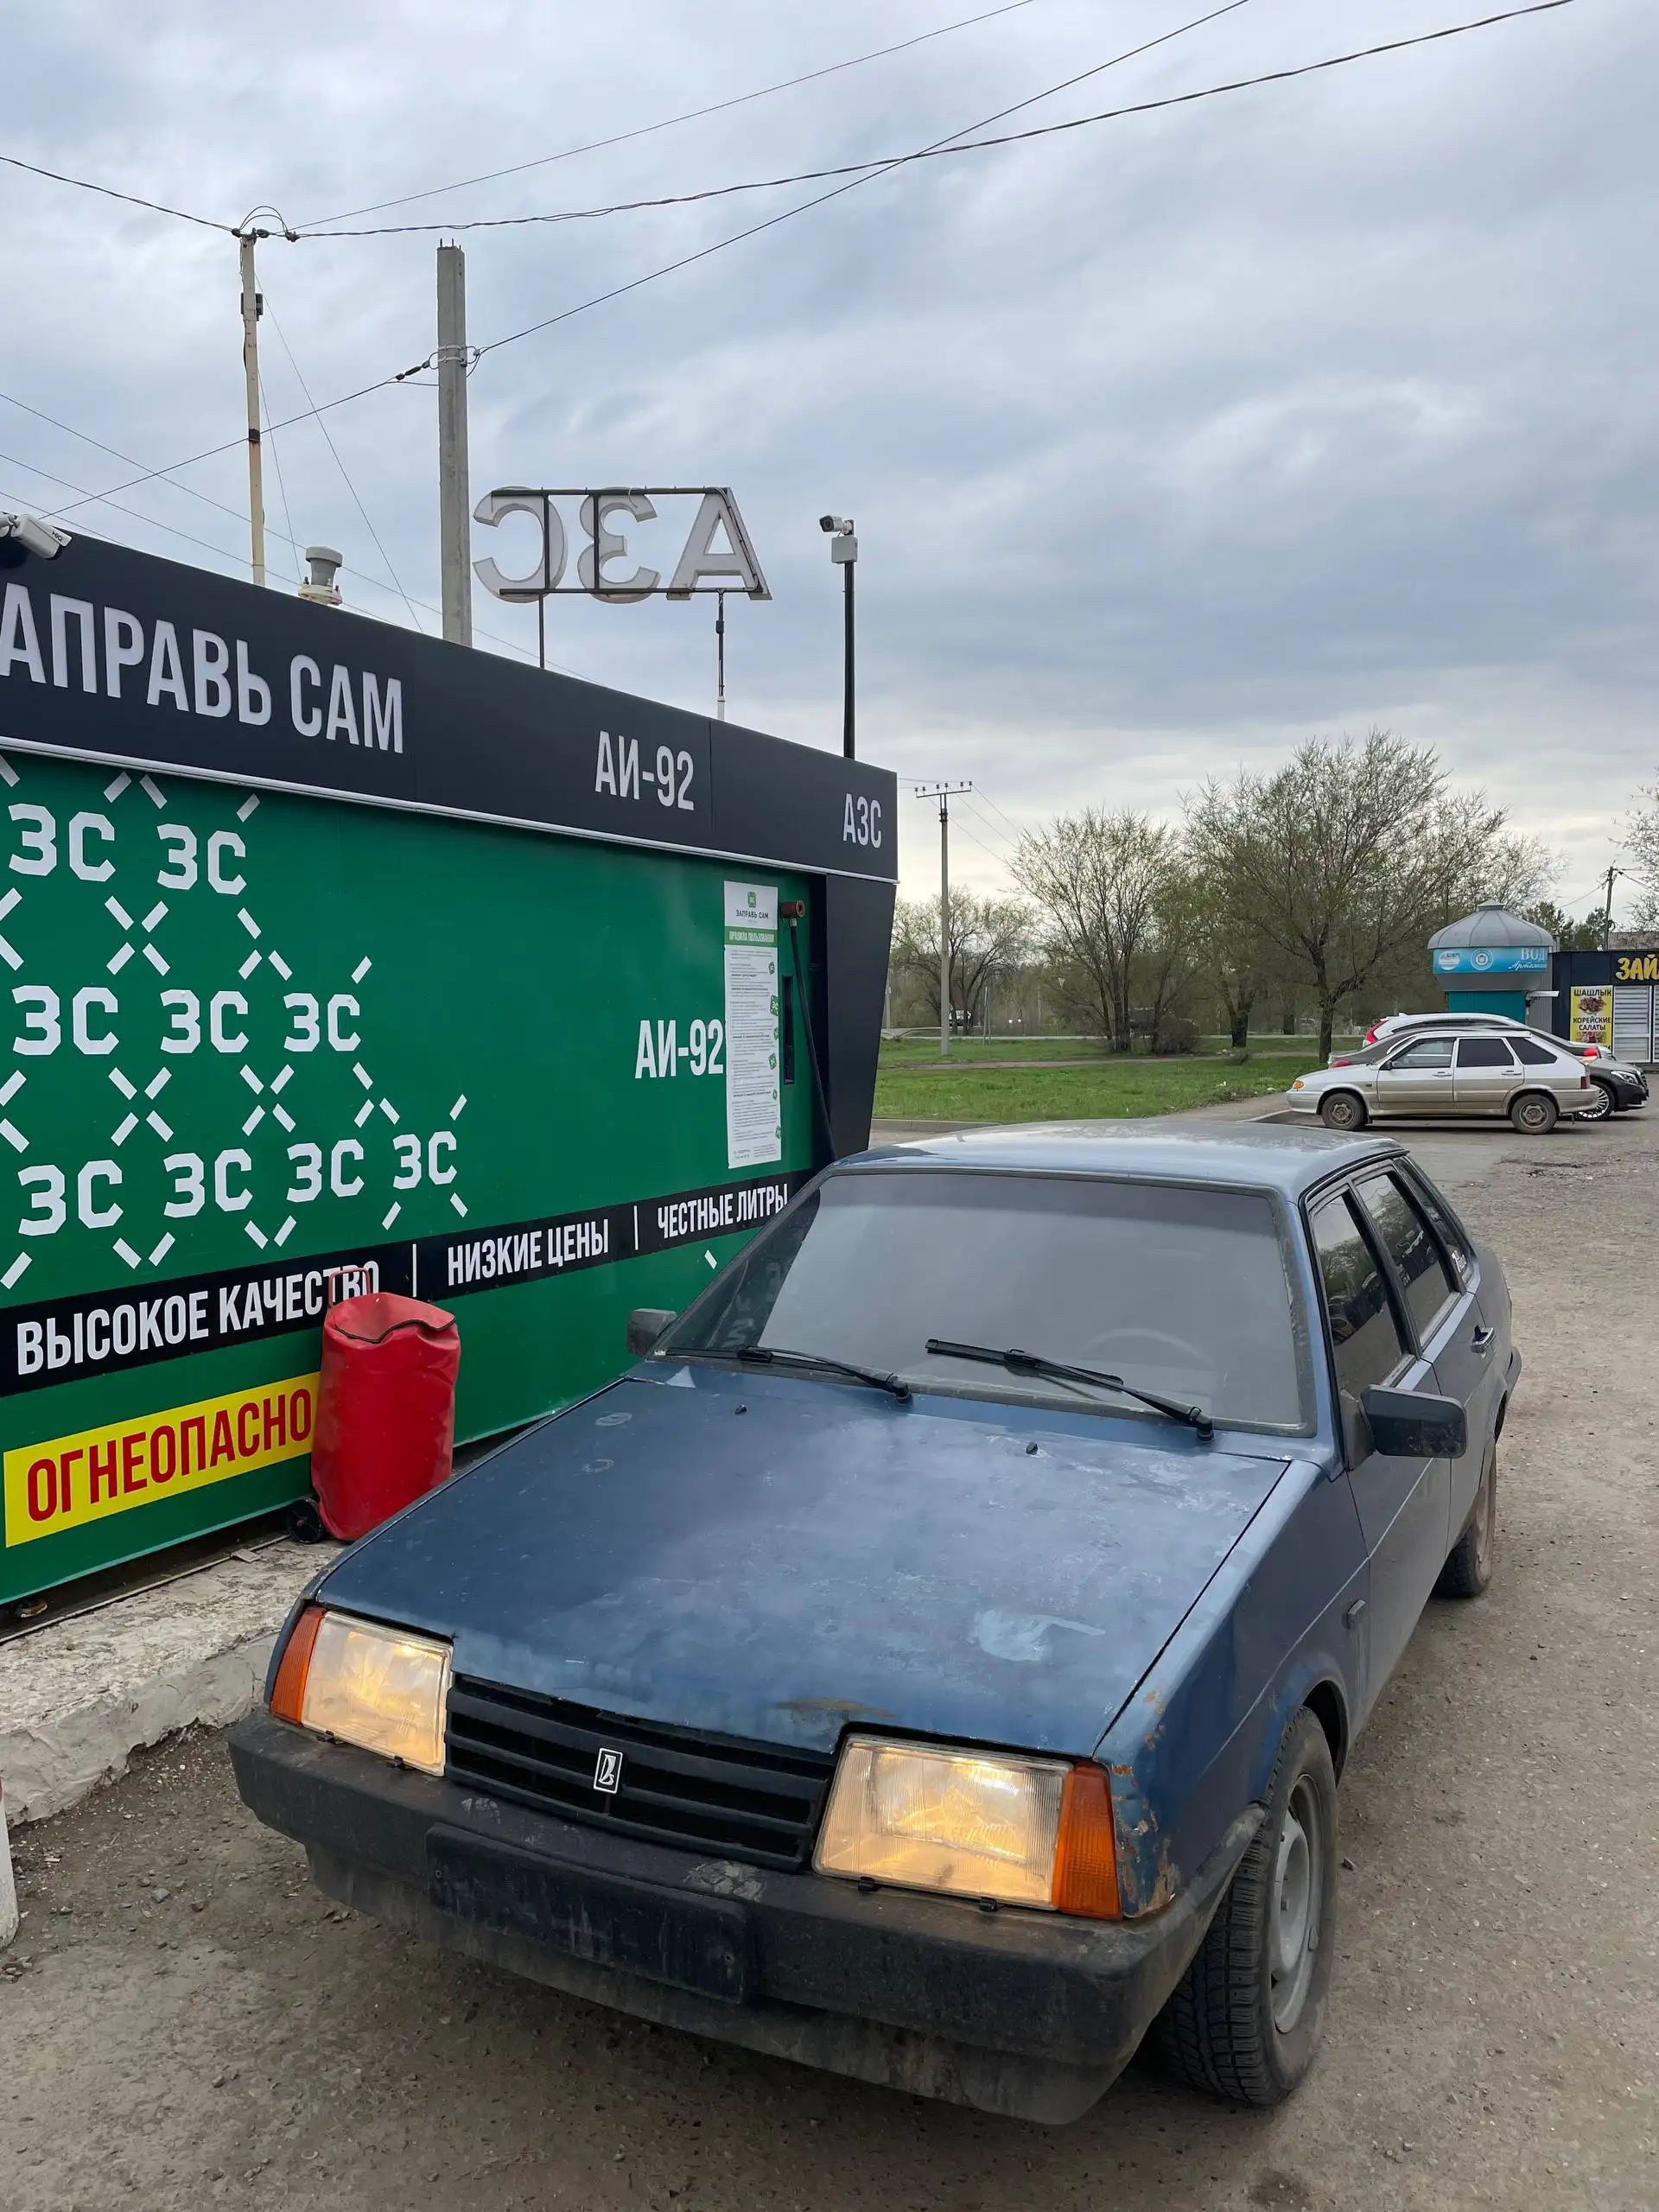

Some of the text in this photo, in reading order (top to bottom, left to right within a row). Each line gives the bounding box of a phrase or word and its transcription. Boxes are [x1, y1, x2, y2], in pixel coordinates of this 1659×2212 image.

[0, 582, 404, 753] АПРАВЬ САМ
[594, 730, 695, 810] АИ-92
[8, 804, 116, 882] ЗС
[842, 793, 881, 849] АЗС
[156, 823, 247, 895] ЗС
[736, 910, 757, 918] ЗАПРАВЬ
[12, 985, 119, 1055] ЗС
[160, 988, 249, 1053] ЗС
[283, 993, 361, 1052] ЗС
[634, 1019, 723, 1079] АИ-92
[163, 1148, 253, 1218] ЗС
[286, 1139, 365, 1203] ЗС
[392, 1130, 457, 1190] ЗС
[17, 1160, 124, 1236] ЗС
[658, 1184, 788, 1239] ЧЕСТНЫЕ ЛИТРЫ
[448, 1218, 608, 1287] НИЗКИЕ ЦЕНЫ
[17, 1261, 379, 1376] ВЫСОКОЕ КАЧЕСТВО
[27, 1388, 312, 1522] ОГНЕОПАСНО
